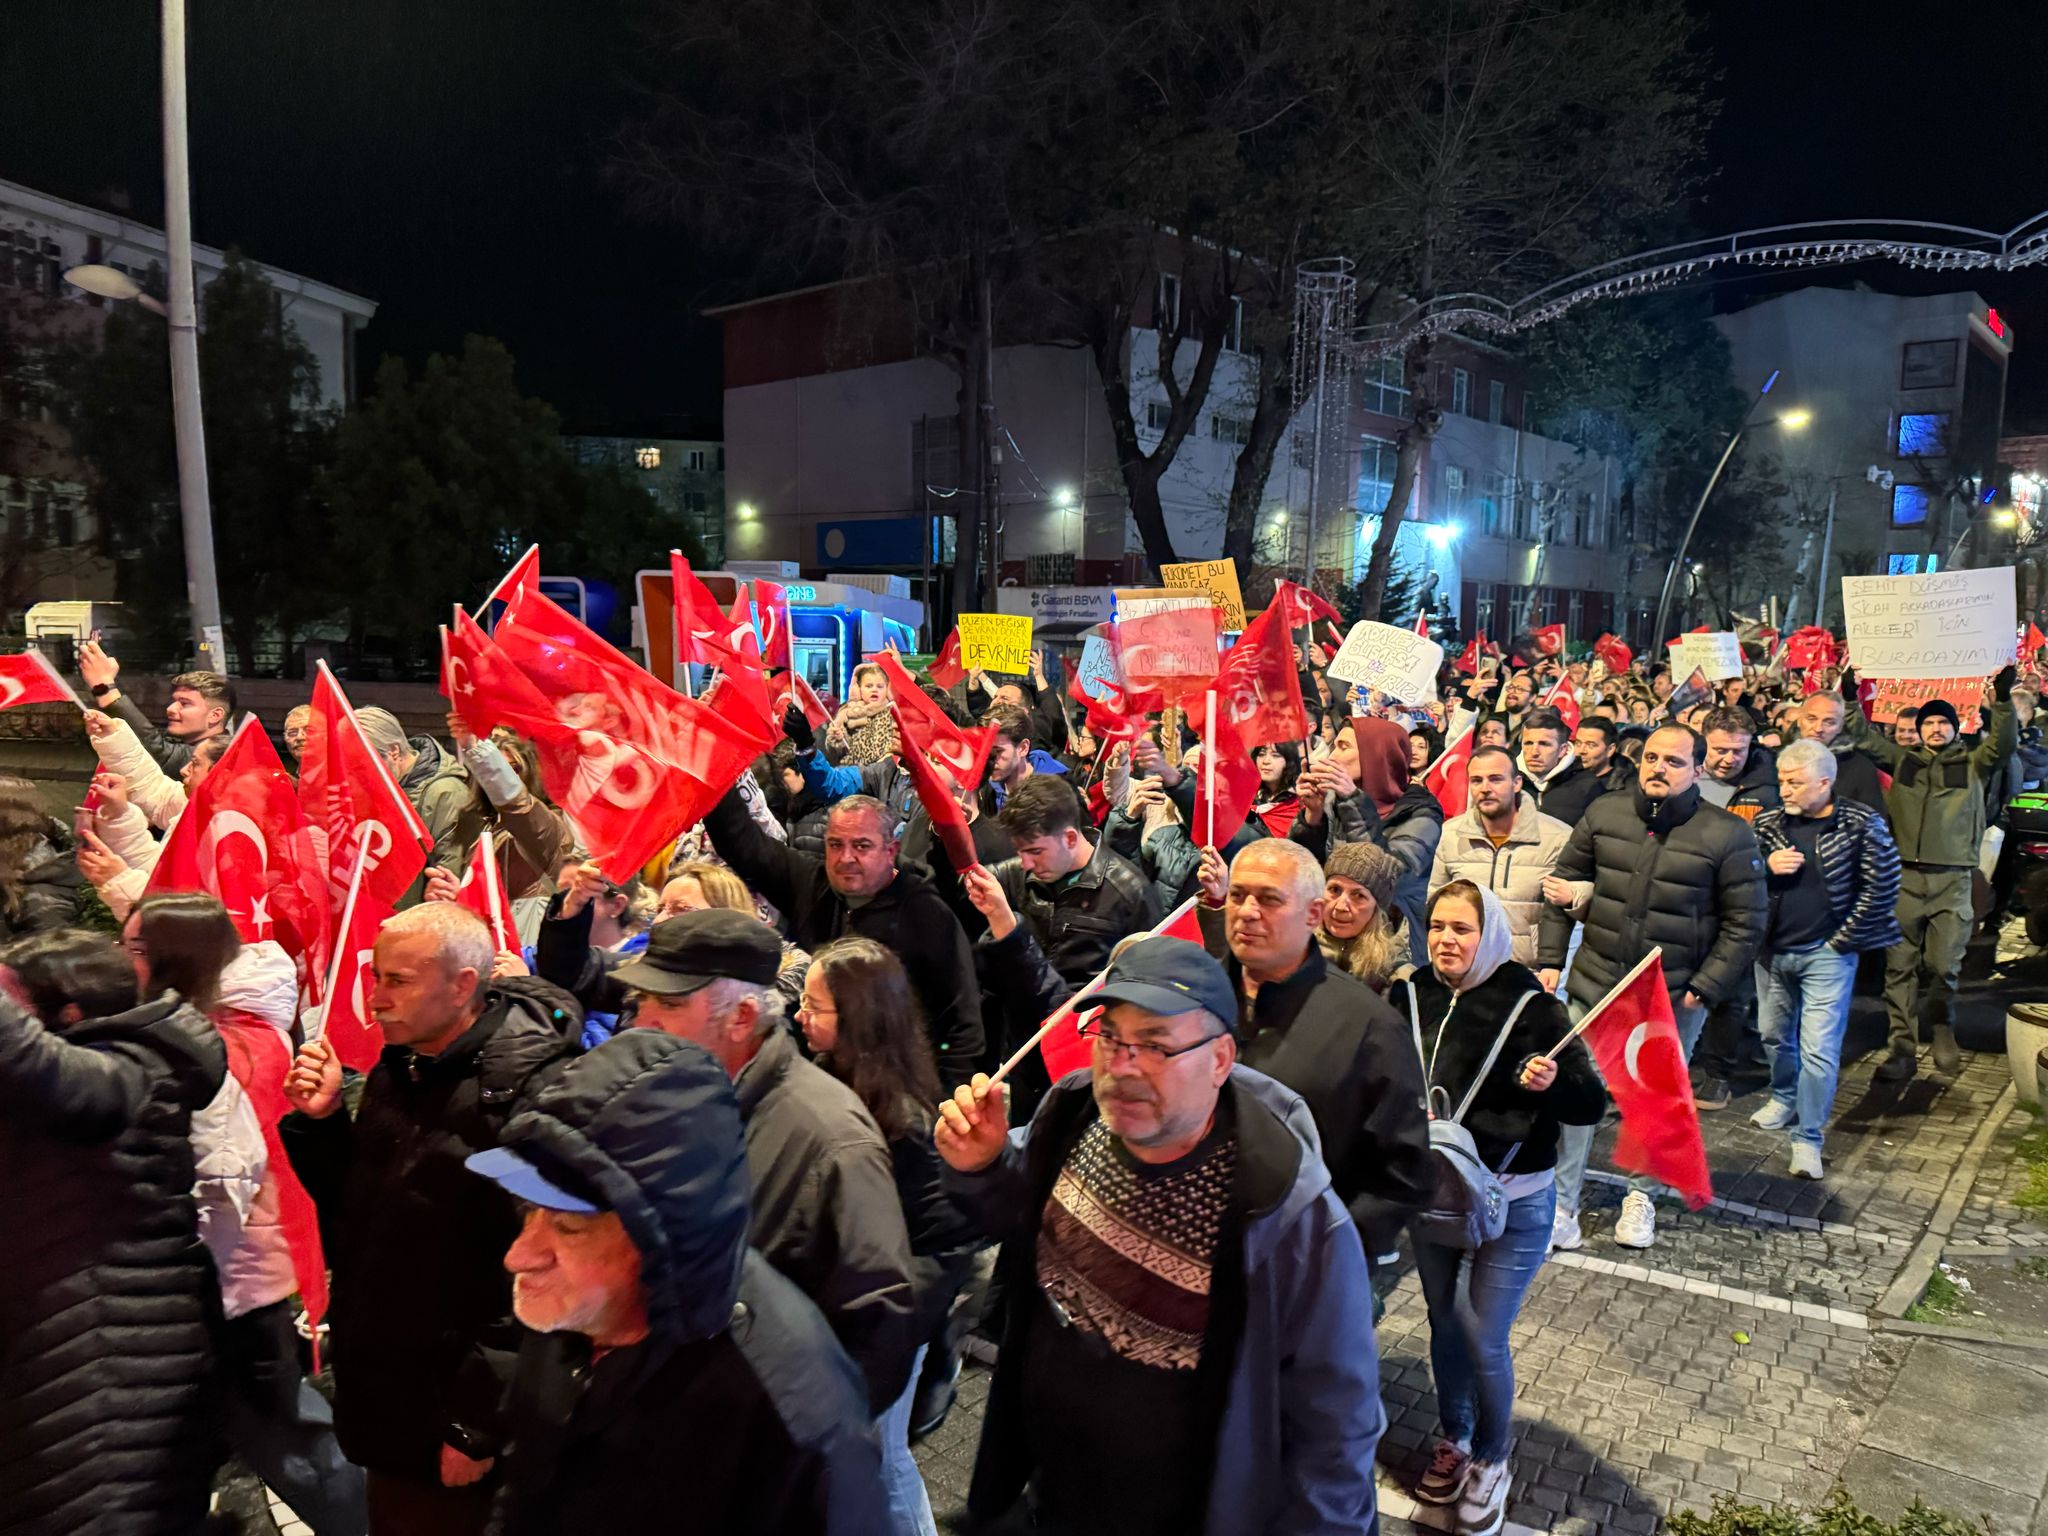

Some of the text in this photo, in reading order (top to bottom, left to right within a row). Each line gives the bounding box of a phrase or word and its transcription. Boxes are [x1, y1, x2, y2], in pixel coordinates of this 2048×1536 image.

[1207, 562, 1226, 577] BU
[1041, 593, 1102, 606] Garanti BBVA
